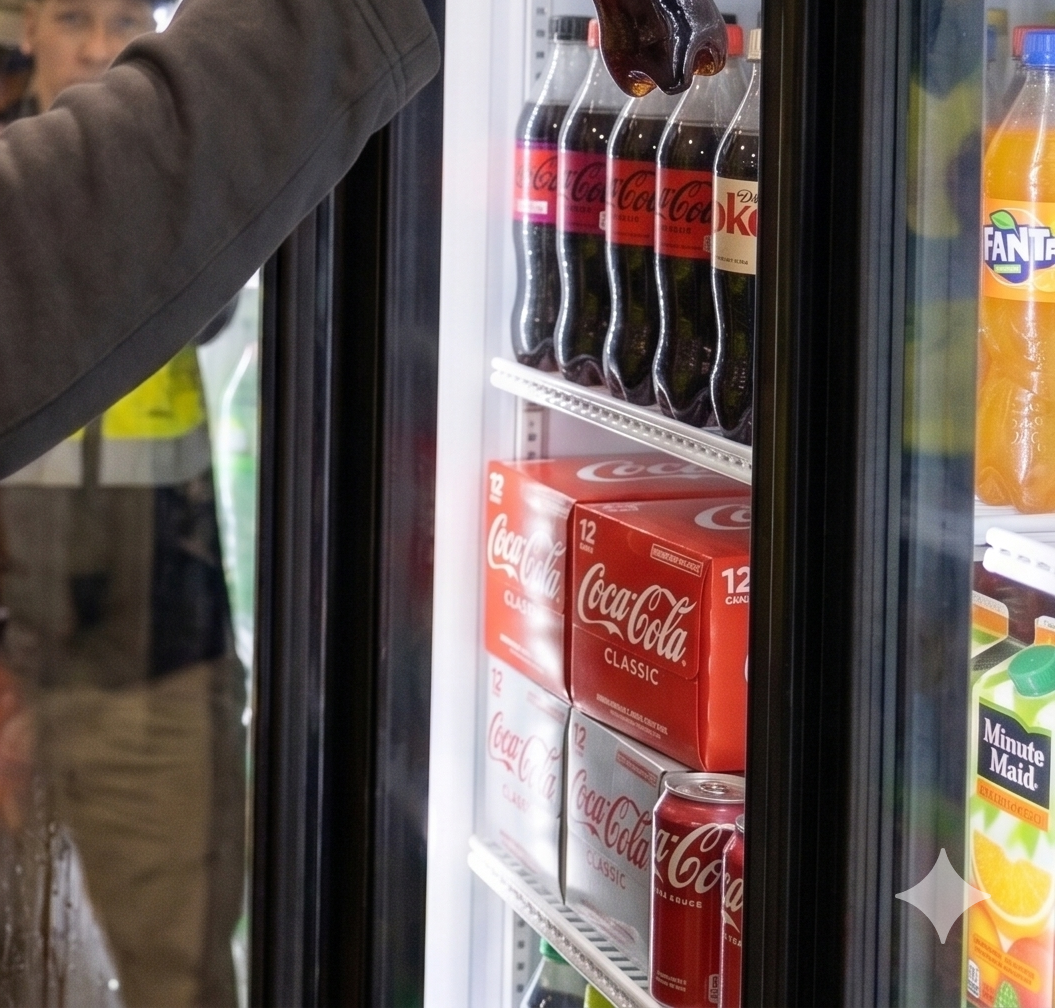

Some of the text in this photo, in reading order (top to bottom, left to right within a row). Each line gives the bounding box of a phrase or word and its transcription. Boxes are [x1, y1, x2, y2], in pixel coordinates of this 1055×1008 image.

[579, 518, 596, 545] 12
[722, 566, 750, 594] 12
[577, 563, 697, 667] Coca-Cola
[604, 647, 659, 685] CLASSIC
[573, 722, 586, 751] 12
[983, 717, 1045, 767] Minute
[989, 746, 1036, 792] Maid
[586, 850, 627, 890] CLASSIC
